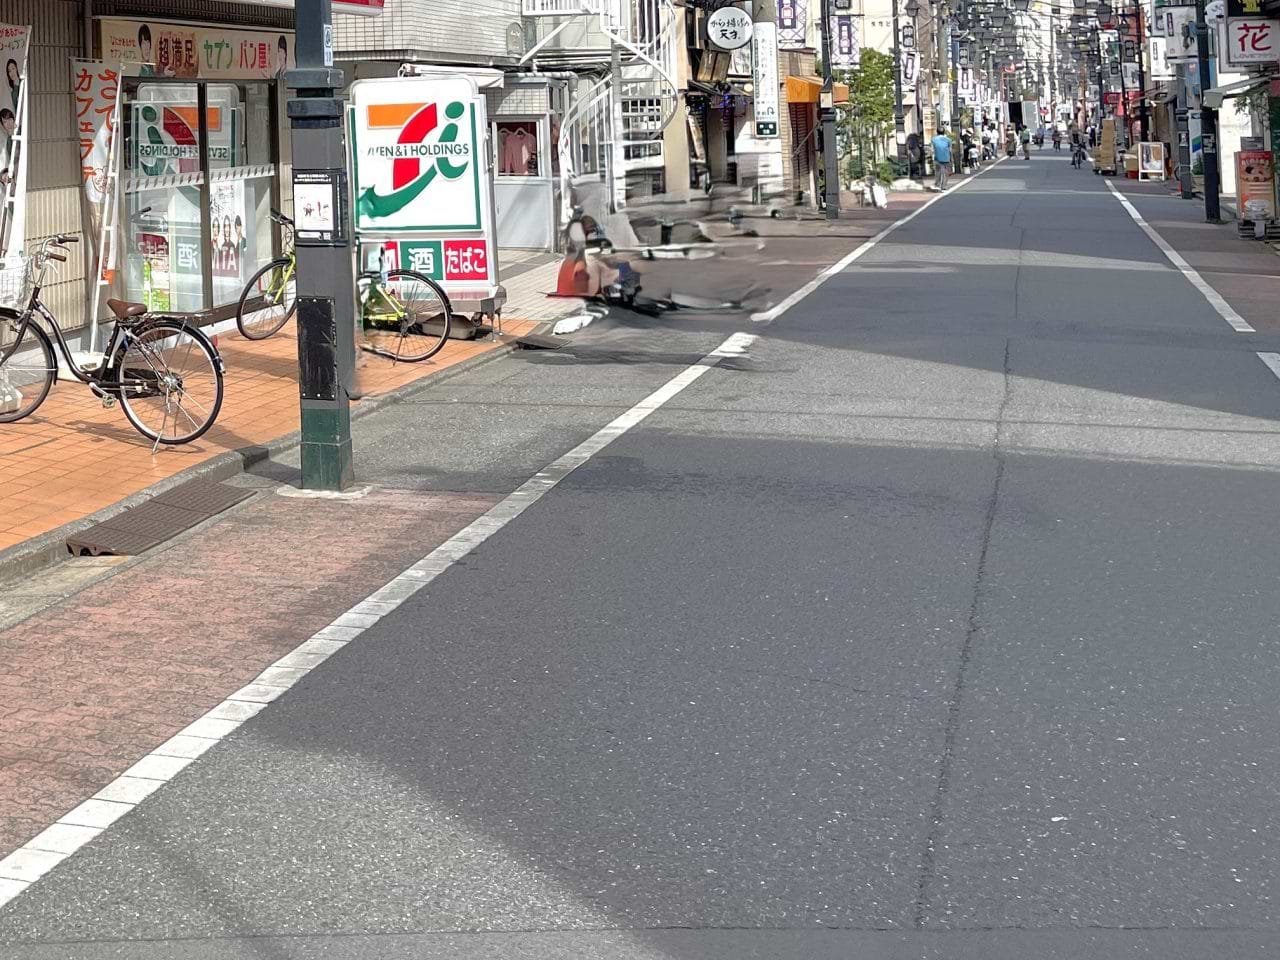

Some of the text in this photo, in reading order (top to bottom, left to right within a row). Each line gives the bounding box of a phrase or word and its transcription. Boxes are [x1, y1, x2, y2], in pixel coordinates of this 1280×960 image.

[1237, 23, 1271, 51] 花
[159, 36, 195, 68] 超満足
[74, 68, 97, 184] カフェラテ
[411, 144, 469, 156] HOLDINGS
[408, 247, 434, 273] 酒
[445, 246, 486, 273] たばこ
